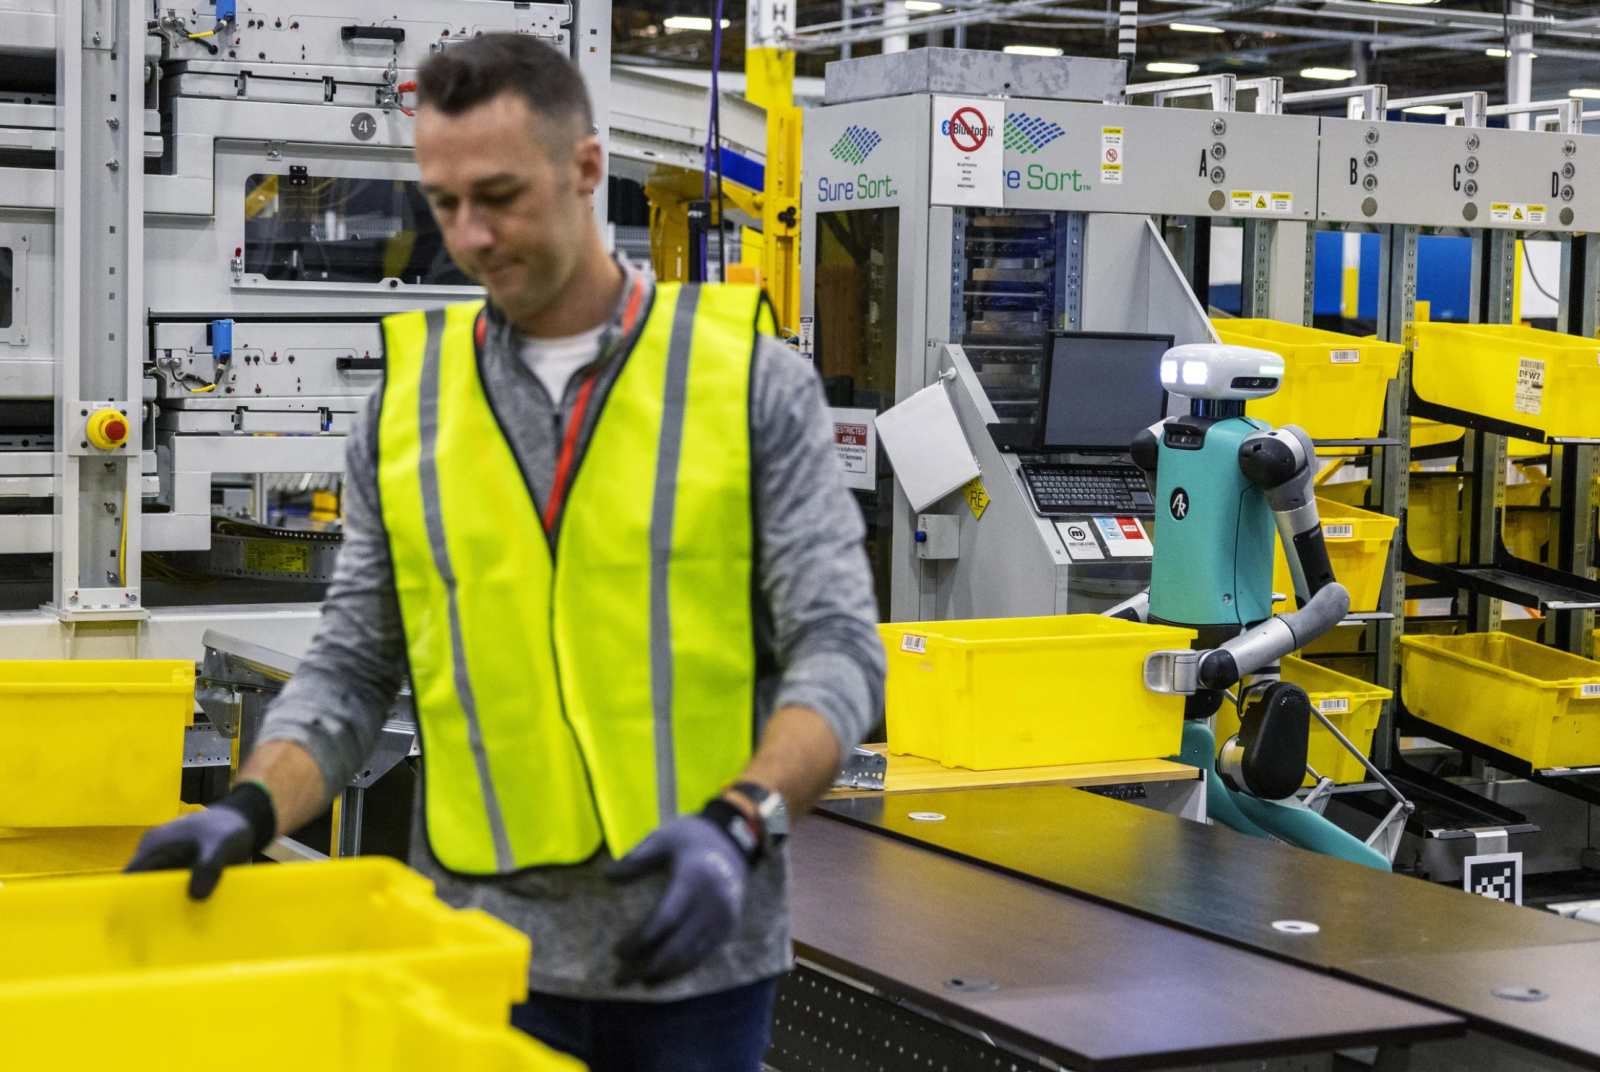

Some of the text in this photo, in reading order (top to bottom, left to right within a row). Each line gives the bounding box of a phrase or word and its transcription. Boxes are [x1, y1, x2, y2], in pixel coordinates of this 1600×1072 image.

[358, 120, 368, 133] 4
[953, 122, 994, 137] Blutooh
[1199, 149, 1207, 176] A
[1350, 157, 1357, 185] B
[818, 177, 854, 202] Sure
[1453, 164, 1461, 191] C
[1551, 171, 1559, 198] D
[834, 424, 866, 436] ESTRICTED
[842, 434, 857, 444] AREA
